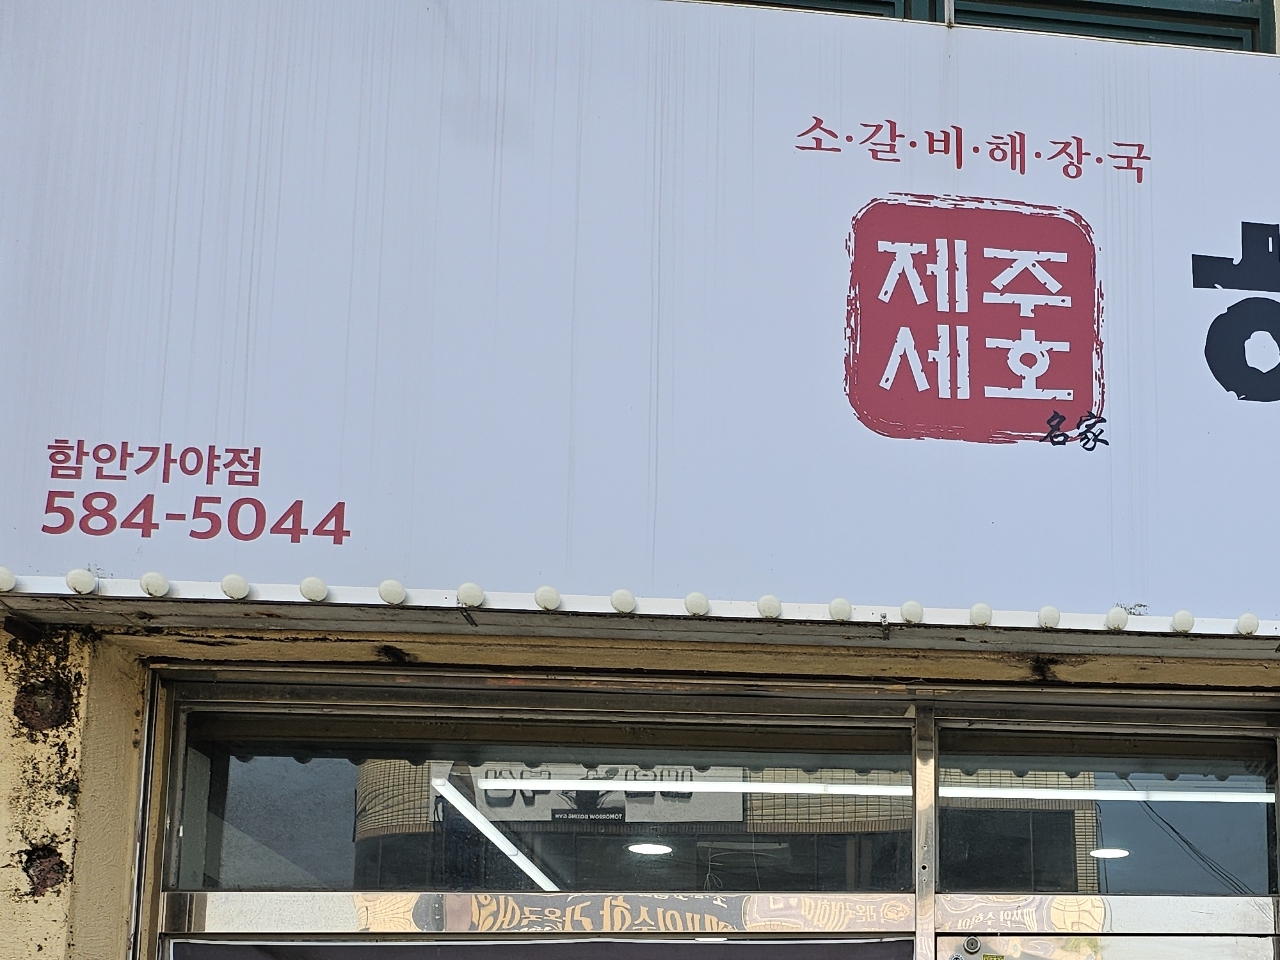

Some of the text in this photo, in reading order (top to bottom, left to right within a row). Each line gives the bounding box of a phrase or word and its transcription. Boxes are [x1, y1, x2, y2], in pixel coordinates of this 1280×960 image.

[877, 239, 1073, 317] 제주
[877, 325, 1074, 400] 세호
[1039, 410, 1110, 452] 名家
[46, 439, 263, 488] 함안가야점
[40, 490, 352, 547] 584-5044
